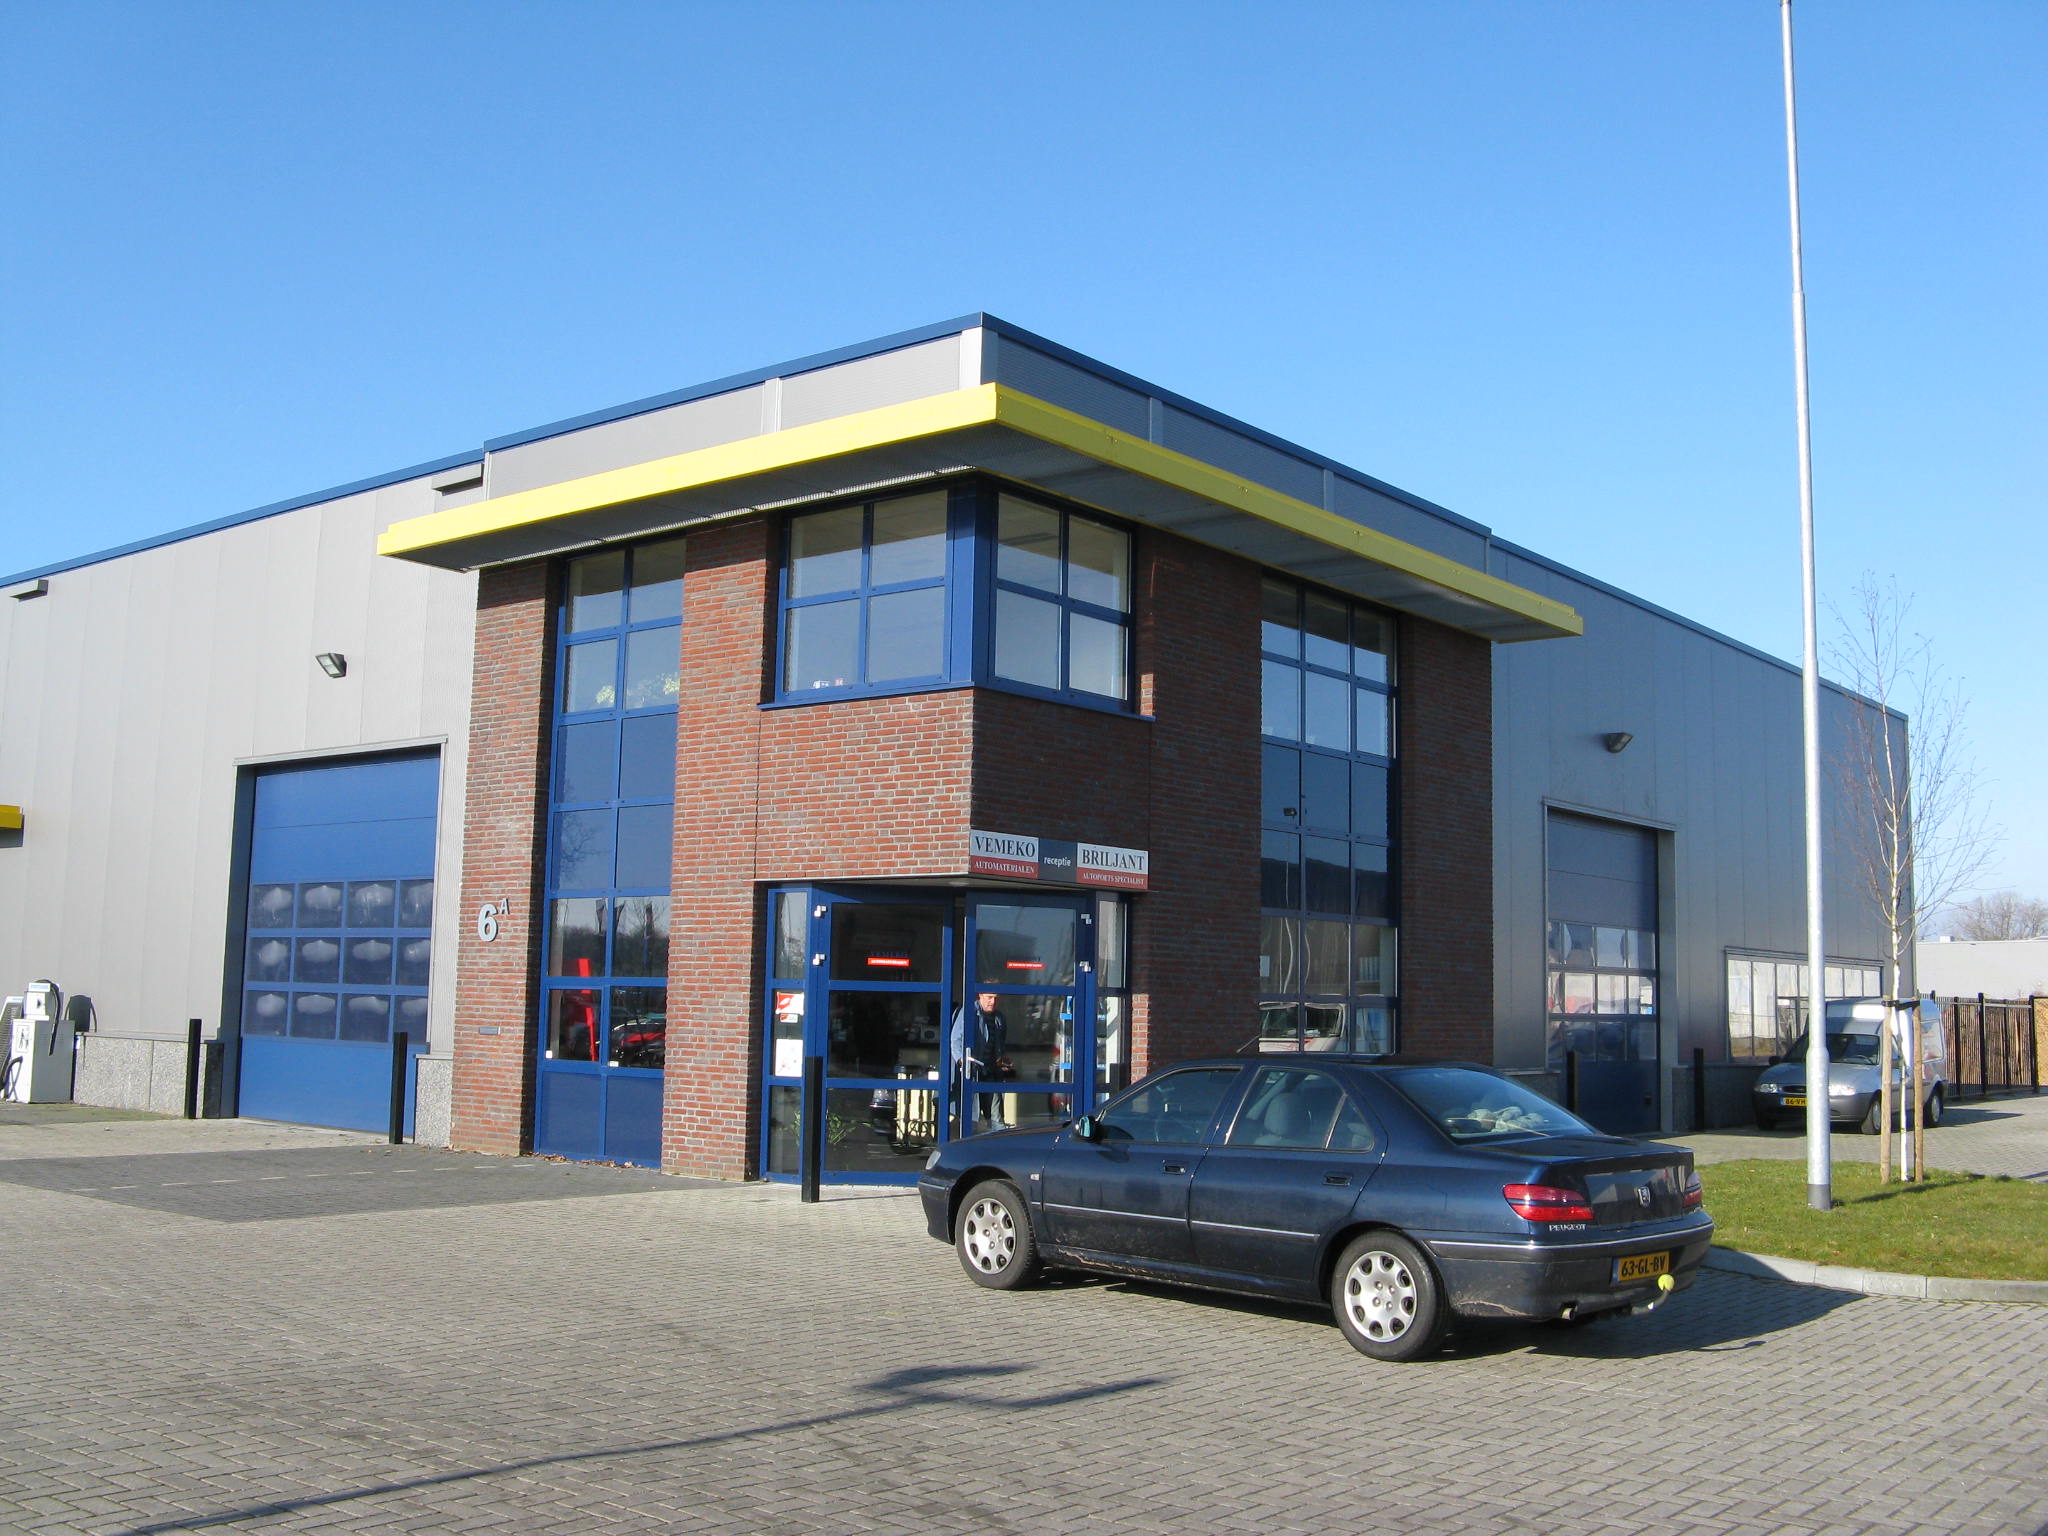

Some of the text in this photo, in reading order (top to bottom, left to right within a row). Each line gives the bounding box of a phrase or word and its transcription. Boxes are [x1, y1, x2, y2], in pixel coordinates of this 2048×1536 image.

[975, 836, 1036, 858] VEMEKO
[975, 860, 1035, 874] AUTOMATERIALEN
[1043, 856, 1072, 868] receptie
[1082, 848, 1145, 871] BRILJANT
[1549, 1223, 1587, 1232] PEUGEOT
[1621, 1256, 1666, 1277] 63-GL-BV
